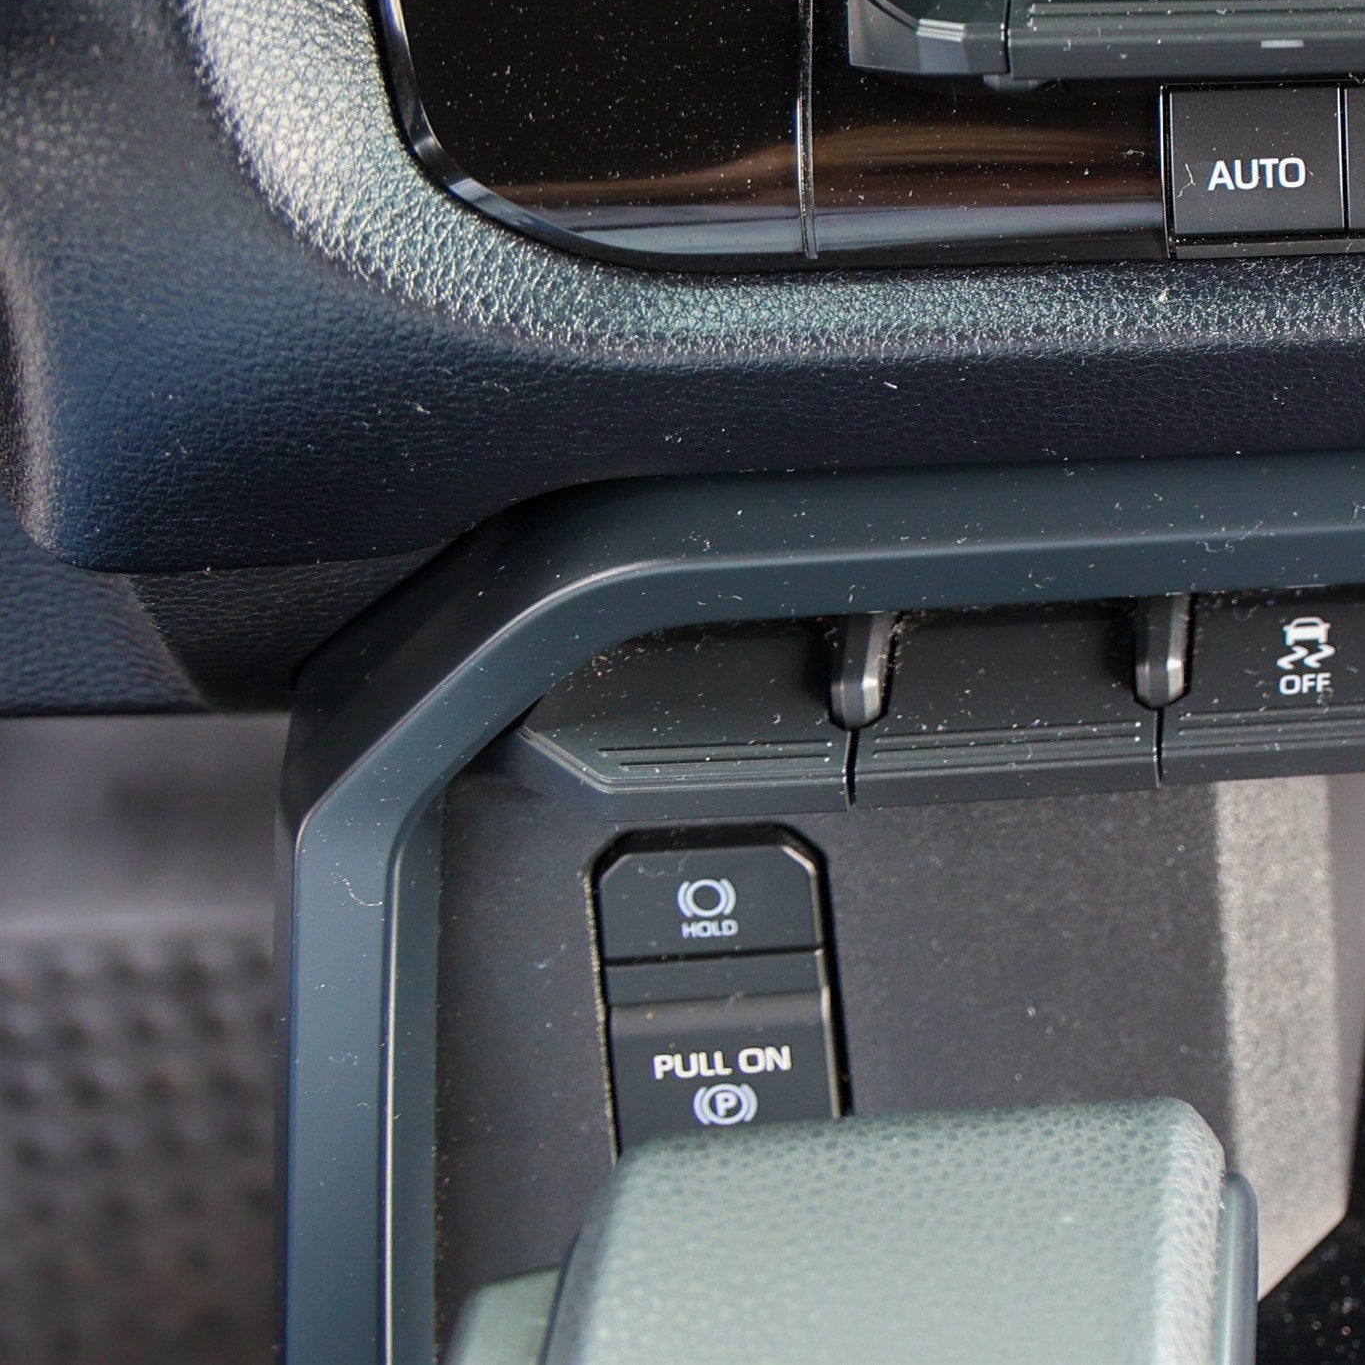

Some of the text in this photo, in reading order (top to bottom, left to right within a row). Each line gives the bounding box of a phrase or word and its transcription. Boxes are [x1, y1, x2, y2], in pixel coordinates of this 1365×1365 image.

[1207, 157, 1306, 191] AUTO
[1278, 671, 1332, 696] OFF
[681, 919, 739, 939] HOLD
[653, 1045, 793, 1081] PULL ON
